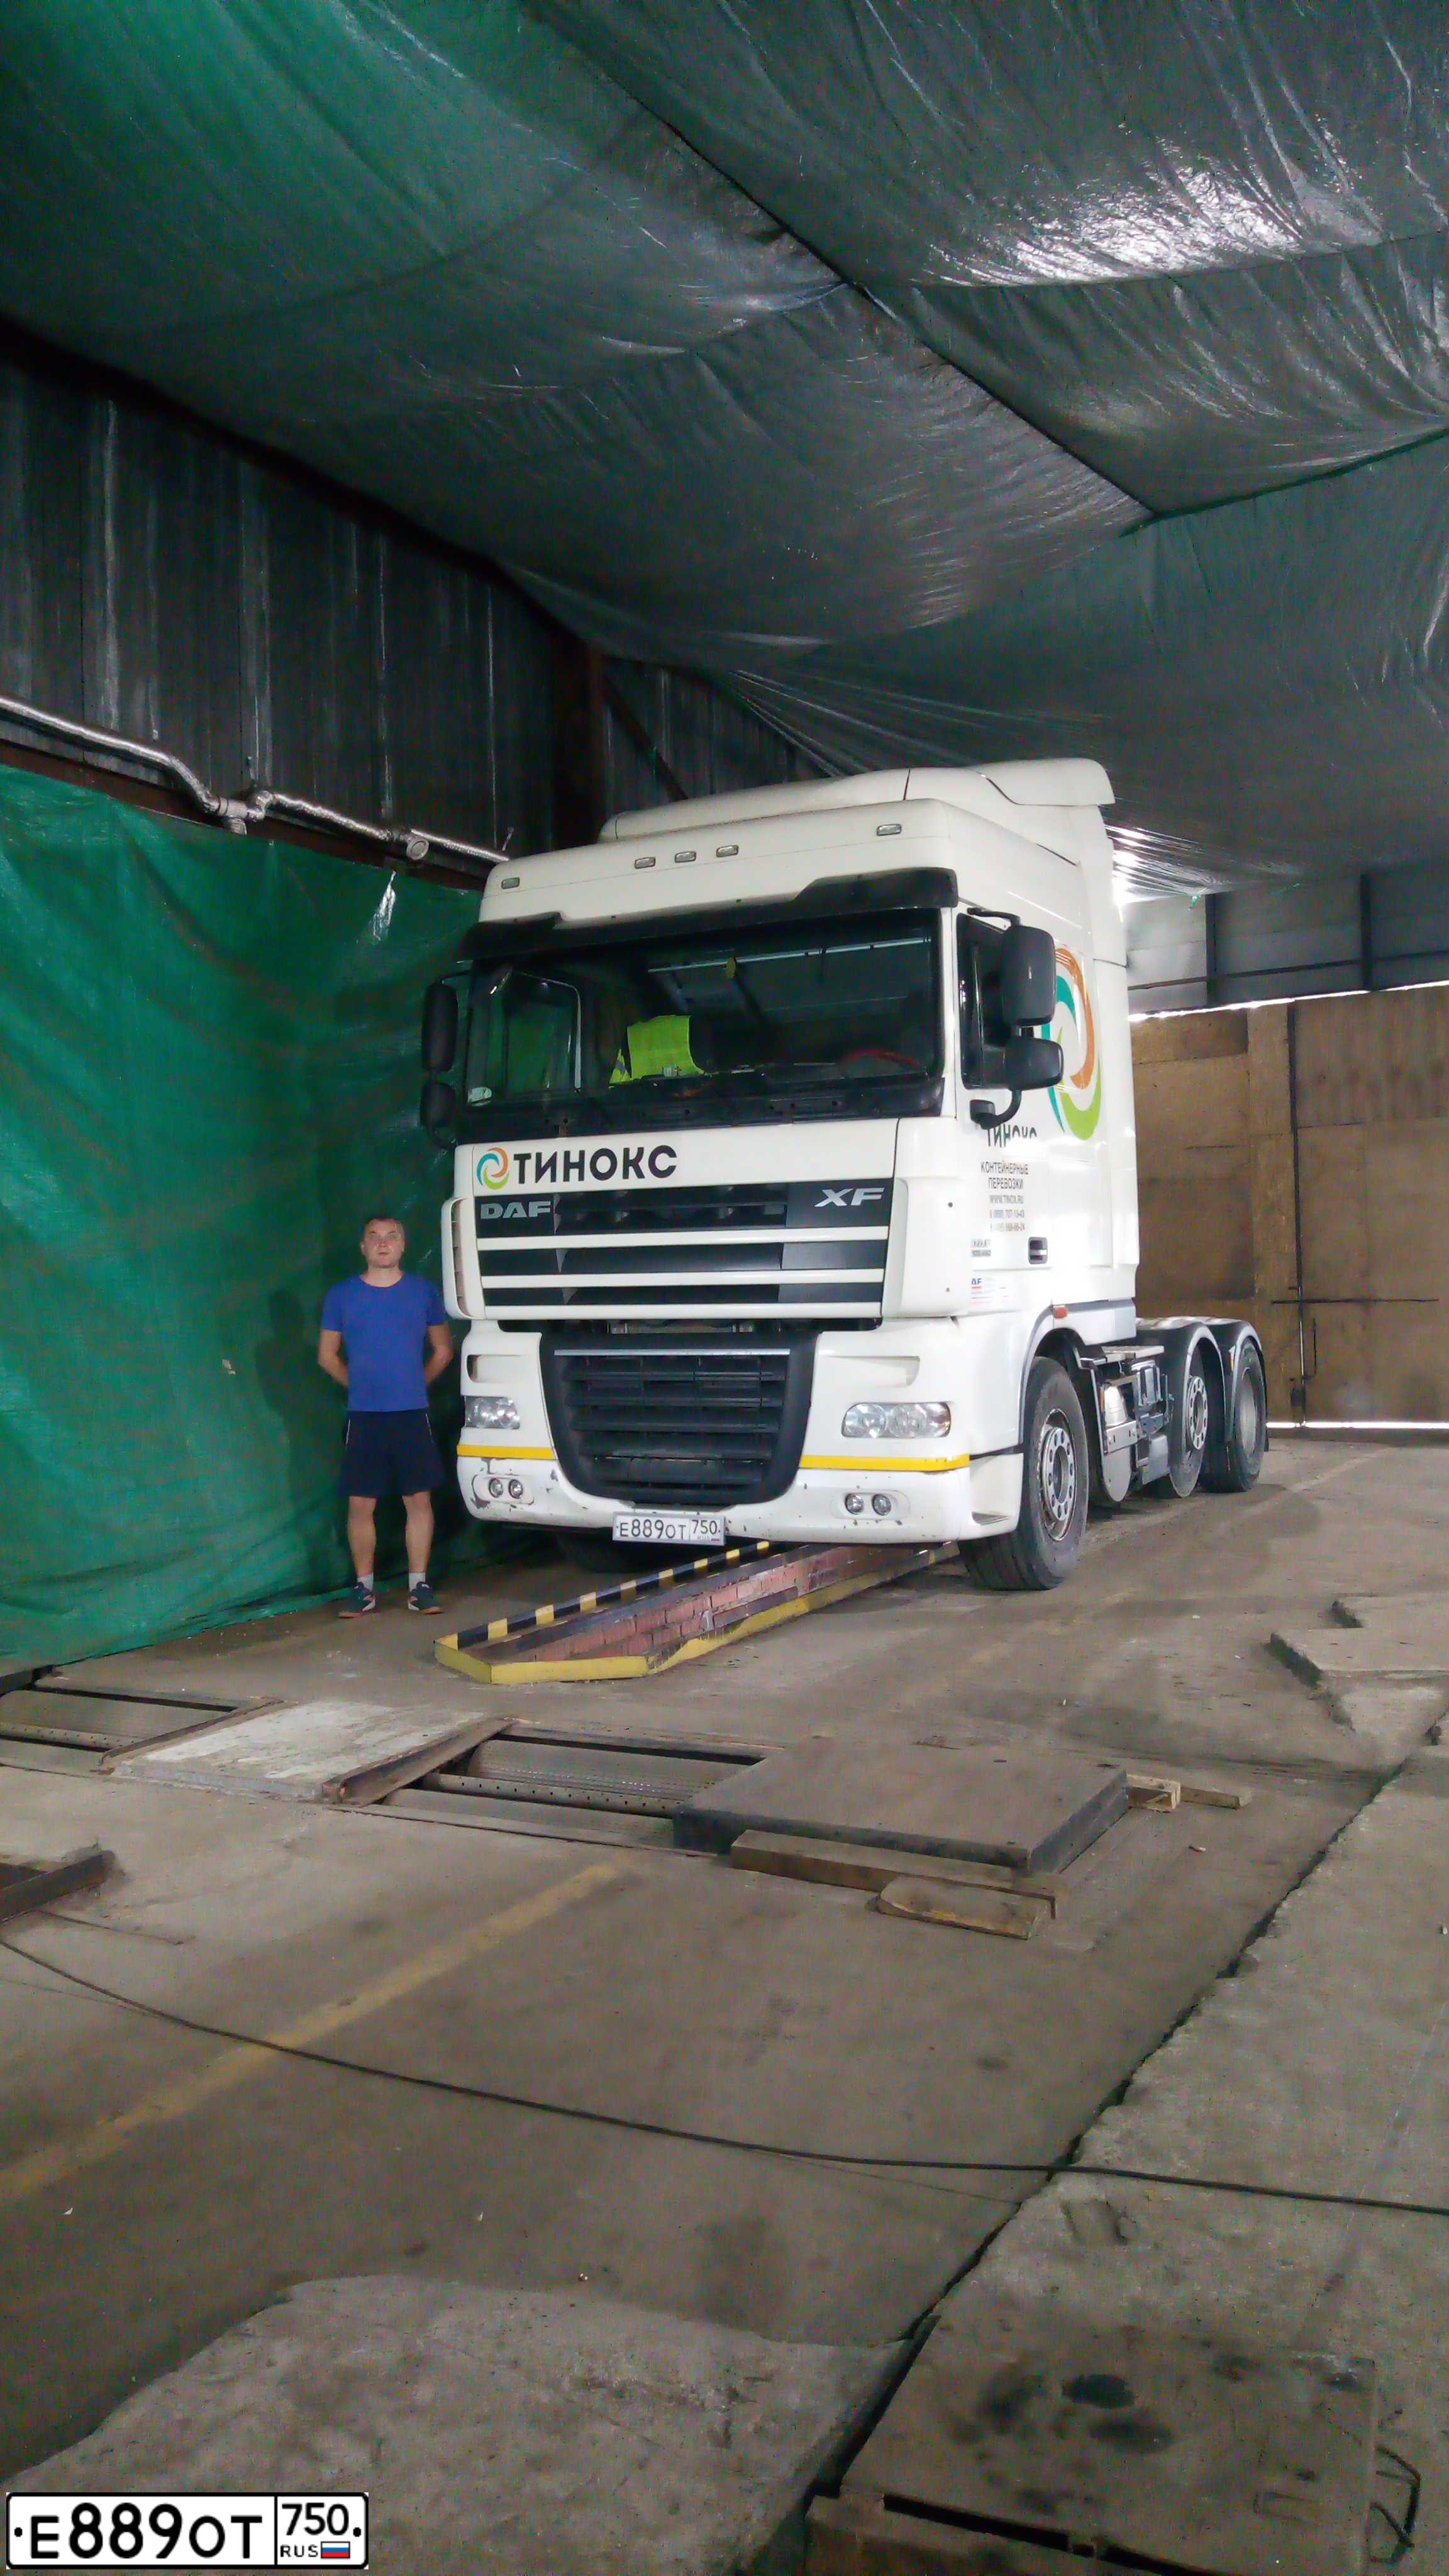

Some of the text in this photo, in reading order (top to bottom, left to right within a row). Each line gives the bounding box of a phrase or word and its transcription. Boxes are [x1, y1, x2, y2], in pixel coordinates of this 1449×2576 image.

[513, 1145, 677, 1185] ТИНОКС
[988, 1177, 1024, 1189] ПЕРЕВОЗКИ
[814, 1187, 885, 1208] XF
[480, 1200, 552, 1219] DAF
[692, 1519, 718, 1535] 750
